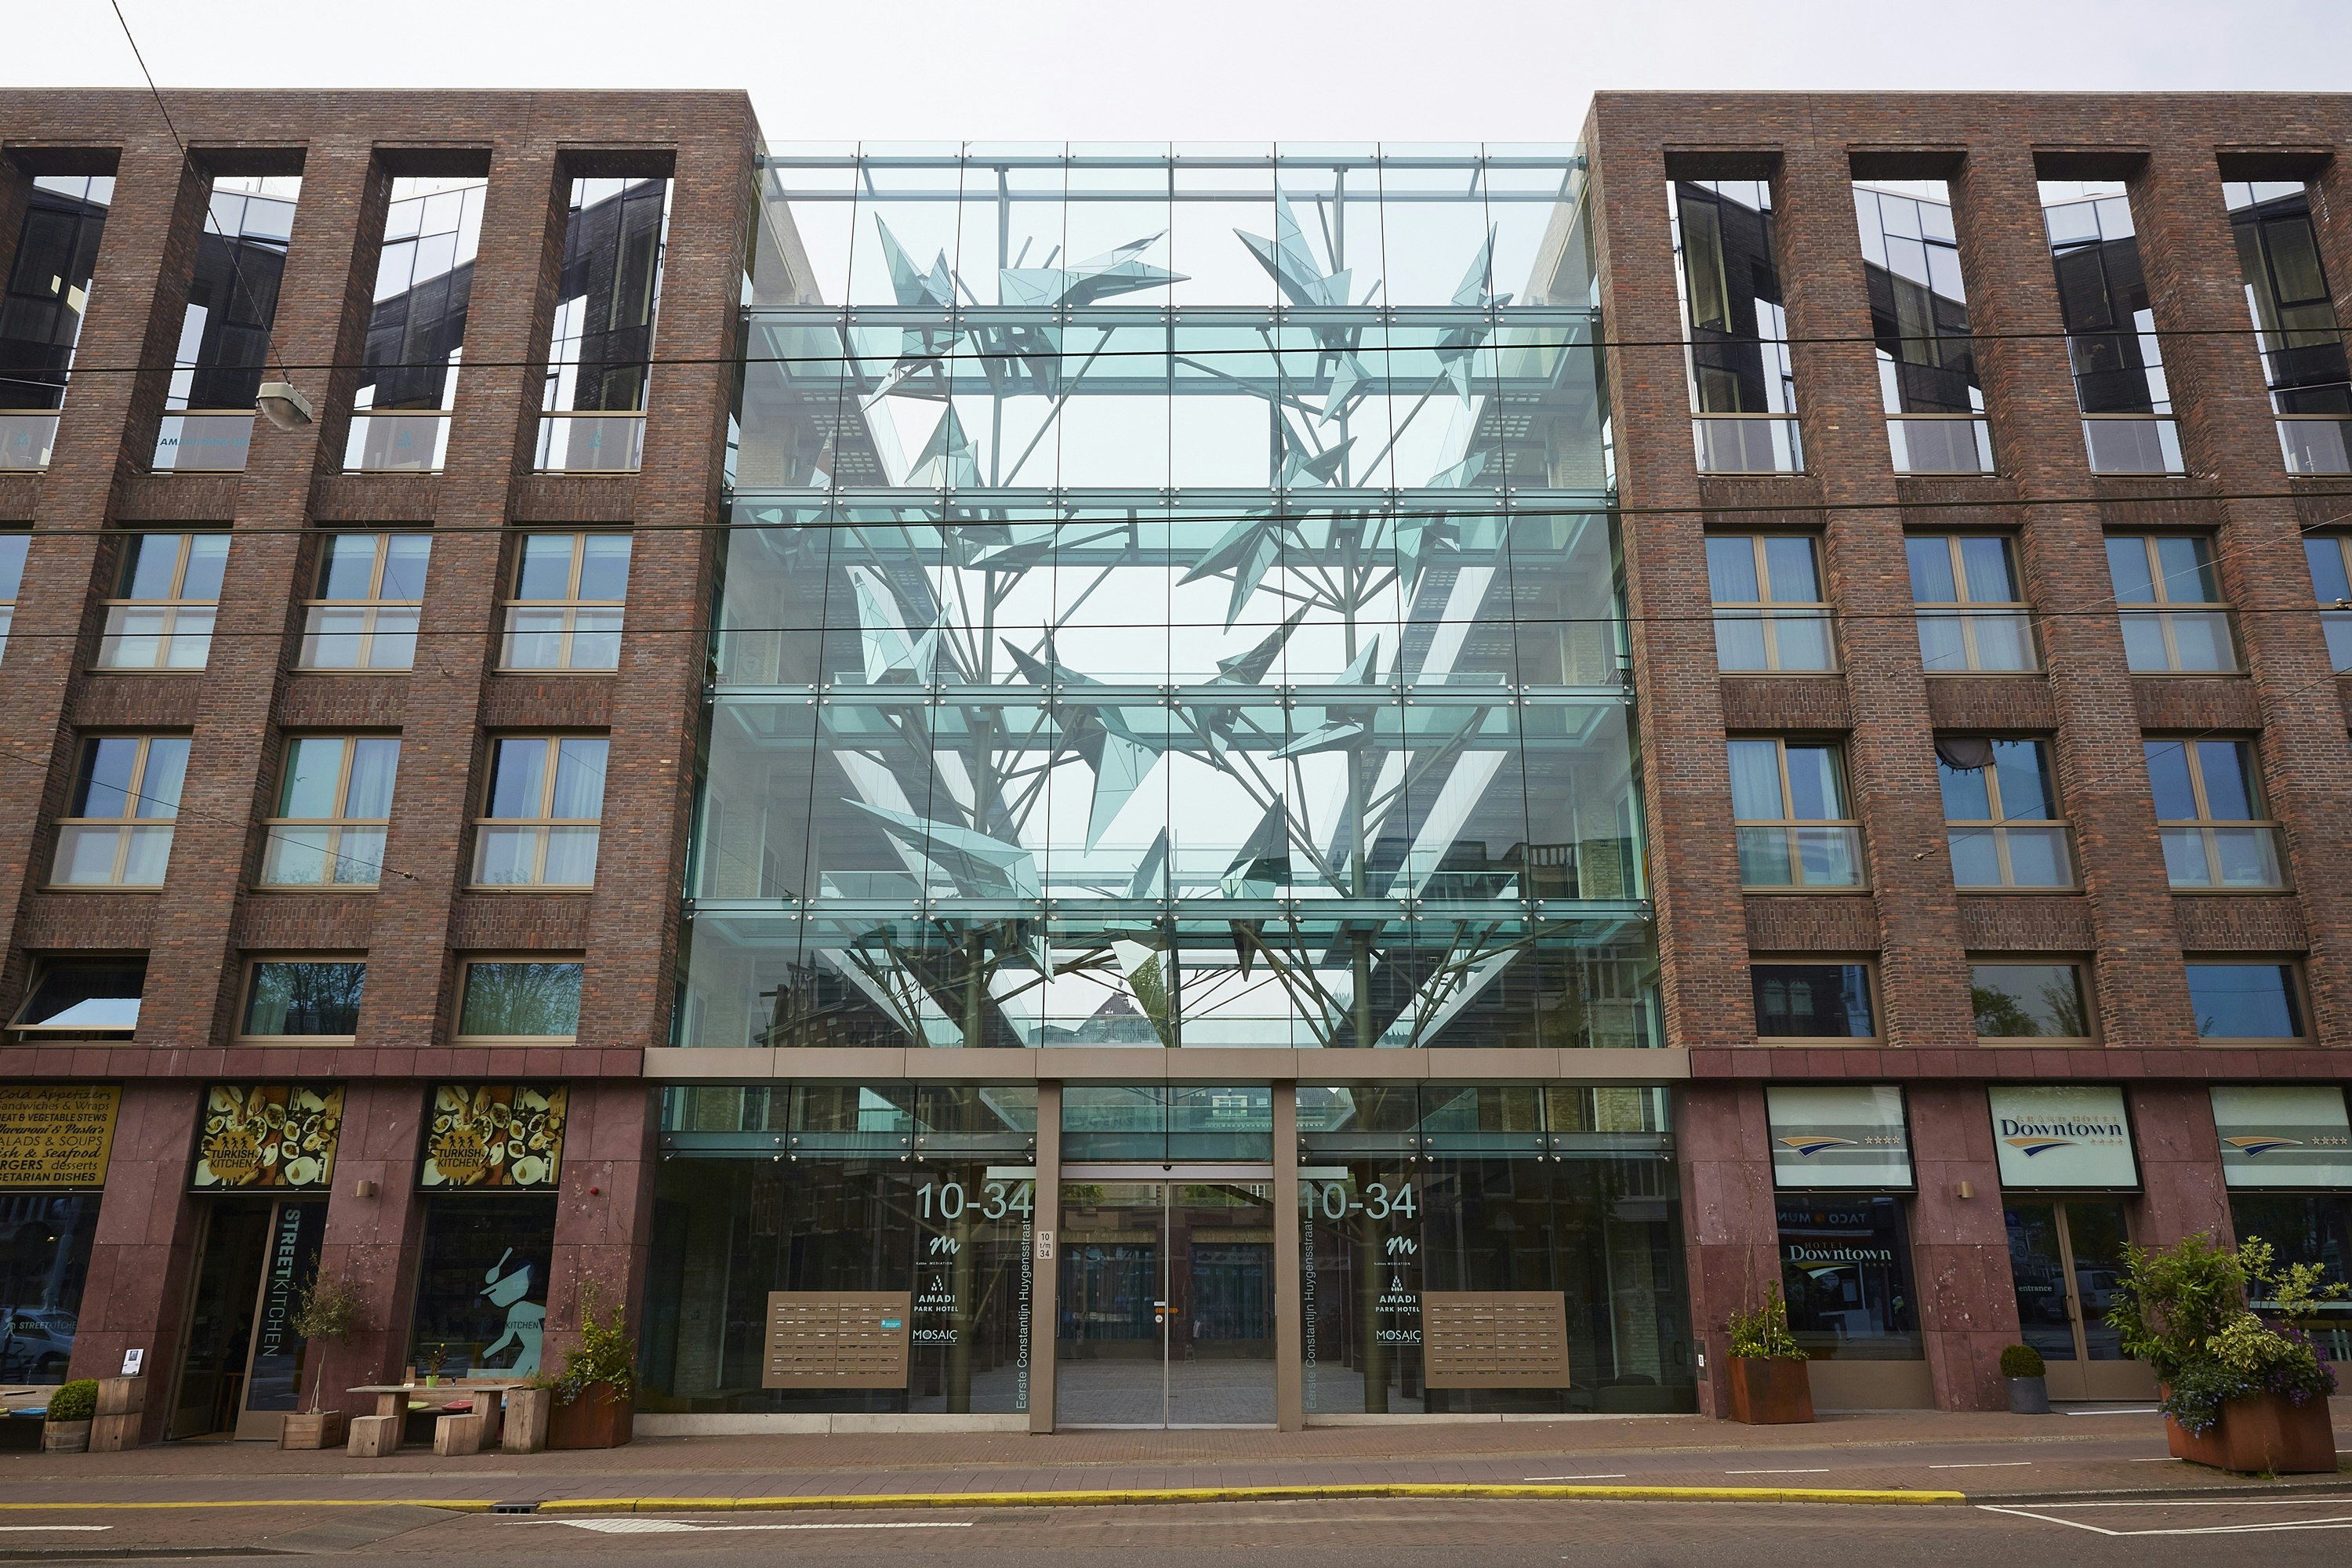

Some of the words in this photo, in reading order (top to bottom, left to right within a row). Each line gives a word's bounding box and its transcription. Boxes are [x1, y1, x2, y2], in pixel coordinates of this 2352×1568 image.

[0, 1089, 31, 1099] Cold
[37, 1089, 111, 1101] Appetizers
[62, 1101, 71, 1110] &
[75, 1101, 110, 1112] Wraps
[0, 1113, 17, 1122] EAT
[28, 1113, 74, 1122] VEGETABLE
[77, 1113, 107, 1122] STEWS
[2016, 1115, 2067, 1123] GRAND
[51, 1125, 62, 1134] &
[2001, 1119, 2123, 1136] Downtown
[45, 1136, 54, 1145] &
[59, 1136, 103, 1145] SOUPS
[24, 1148, 37, 1158] &
[212, 1149, 255, 1158] TURKISH
[438, 1149, 481, 1157] TURKISH
[51, 1160, 98, 1170] desserts
[210, 1159, 252, 1168] KITCHEN
[437, 1158, 480, 1167] KITCHEN
[53, 1173, 96, 1181] DISHES
[916, 1182, 1033, 1219] 10-34
[1299, 1182, 1417, 1220] 10-34
[1789, 1245, 1893, 1261] Downtown
[1018, 1220, 1032, 1301] Huygensstraat
[1304, 1220, 1316, 1301] Huygensstraat
[918, 1294, 956, 1303] AMADI
[1379, 1294, 1416, 1303] AMADI
[505, 1321, 539, 1330] KITCHEN
[912, 1330, 958, 1340] MOSAIC
[1017, 1304, 1030, 1368] Constantijn
[1305, 1304, 1317, 1368] Constantijn
[1376, 1330, 1421, 1341] MOSAIC
[1016, 1371, 1027, 1410] Eerste
[1306, 1372, 1316, 1410] Eerste
